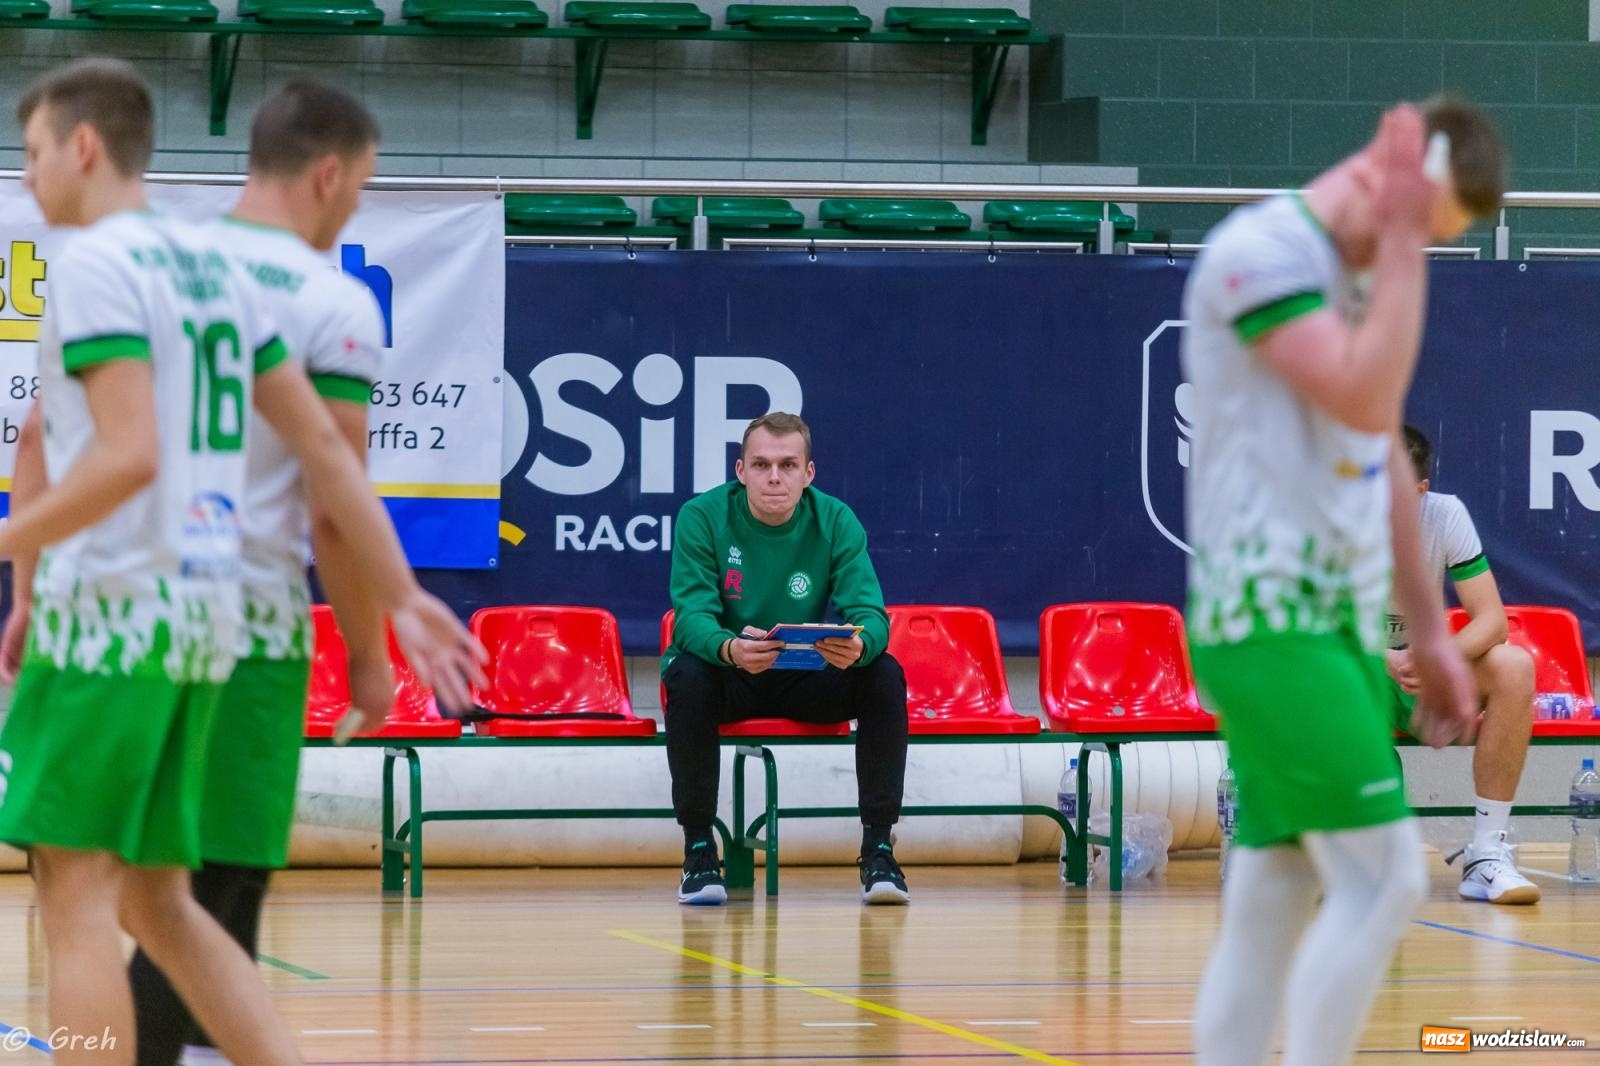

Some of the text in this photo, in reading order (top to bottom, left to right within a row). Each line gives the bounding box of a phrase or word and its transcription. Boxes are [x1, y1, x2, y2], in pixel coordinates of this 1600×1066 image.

[182, 319, 244, 453] 16
[369, 381, 467, 408] 63 647
[501, 352, 804, 496] SiR
[368, 422, 446, 450] rffa 2
